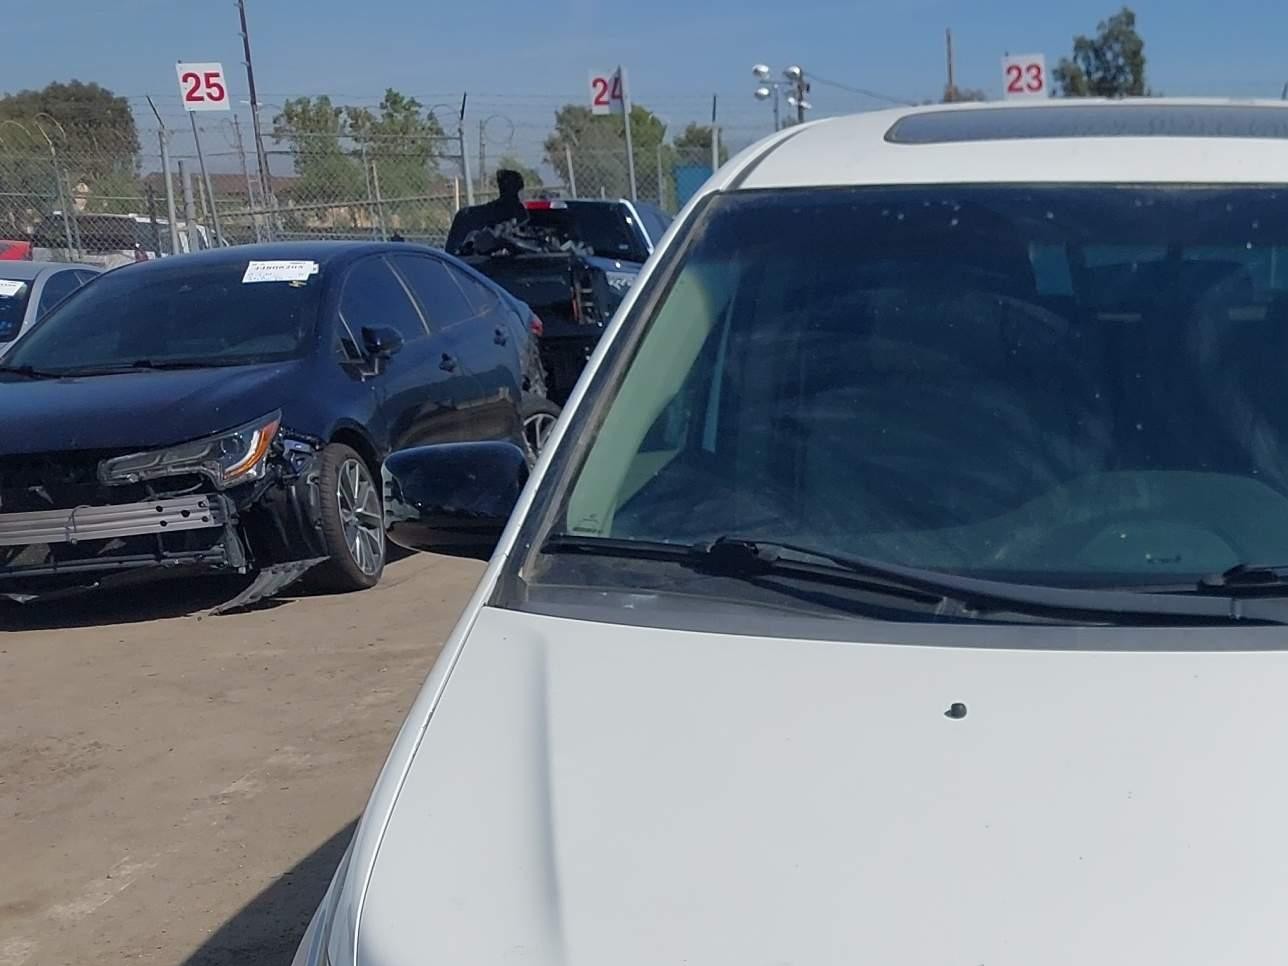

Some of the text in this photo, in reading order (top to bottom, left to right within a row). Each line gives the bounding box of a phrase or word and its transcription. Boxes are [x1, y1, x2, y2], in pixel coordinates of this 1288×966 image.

[181, 72, 225, 102] 25
[592, 76, 623, 106] 24
[1006, 63, 1044, 93] 23
